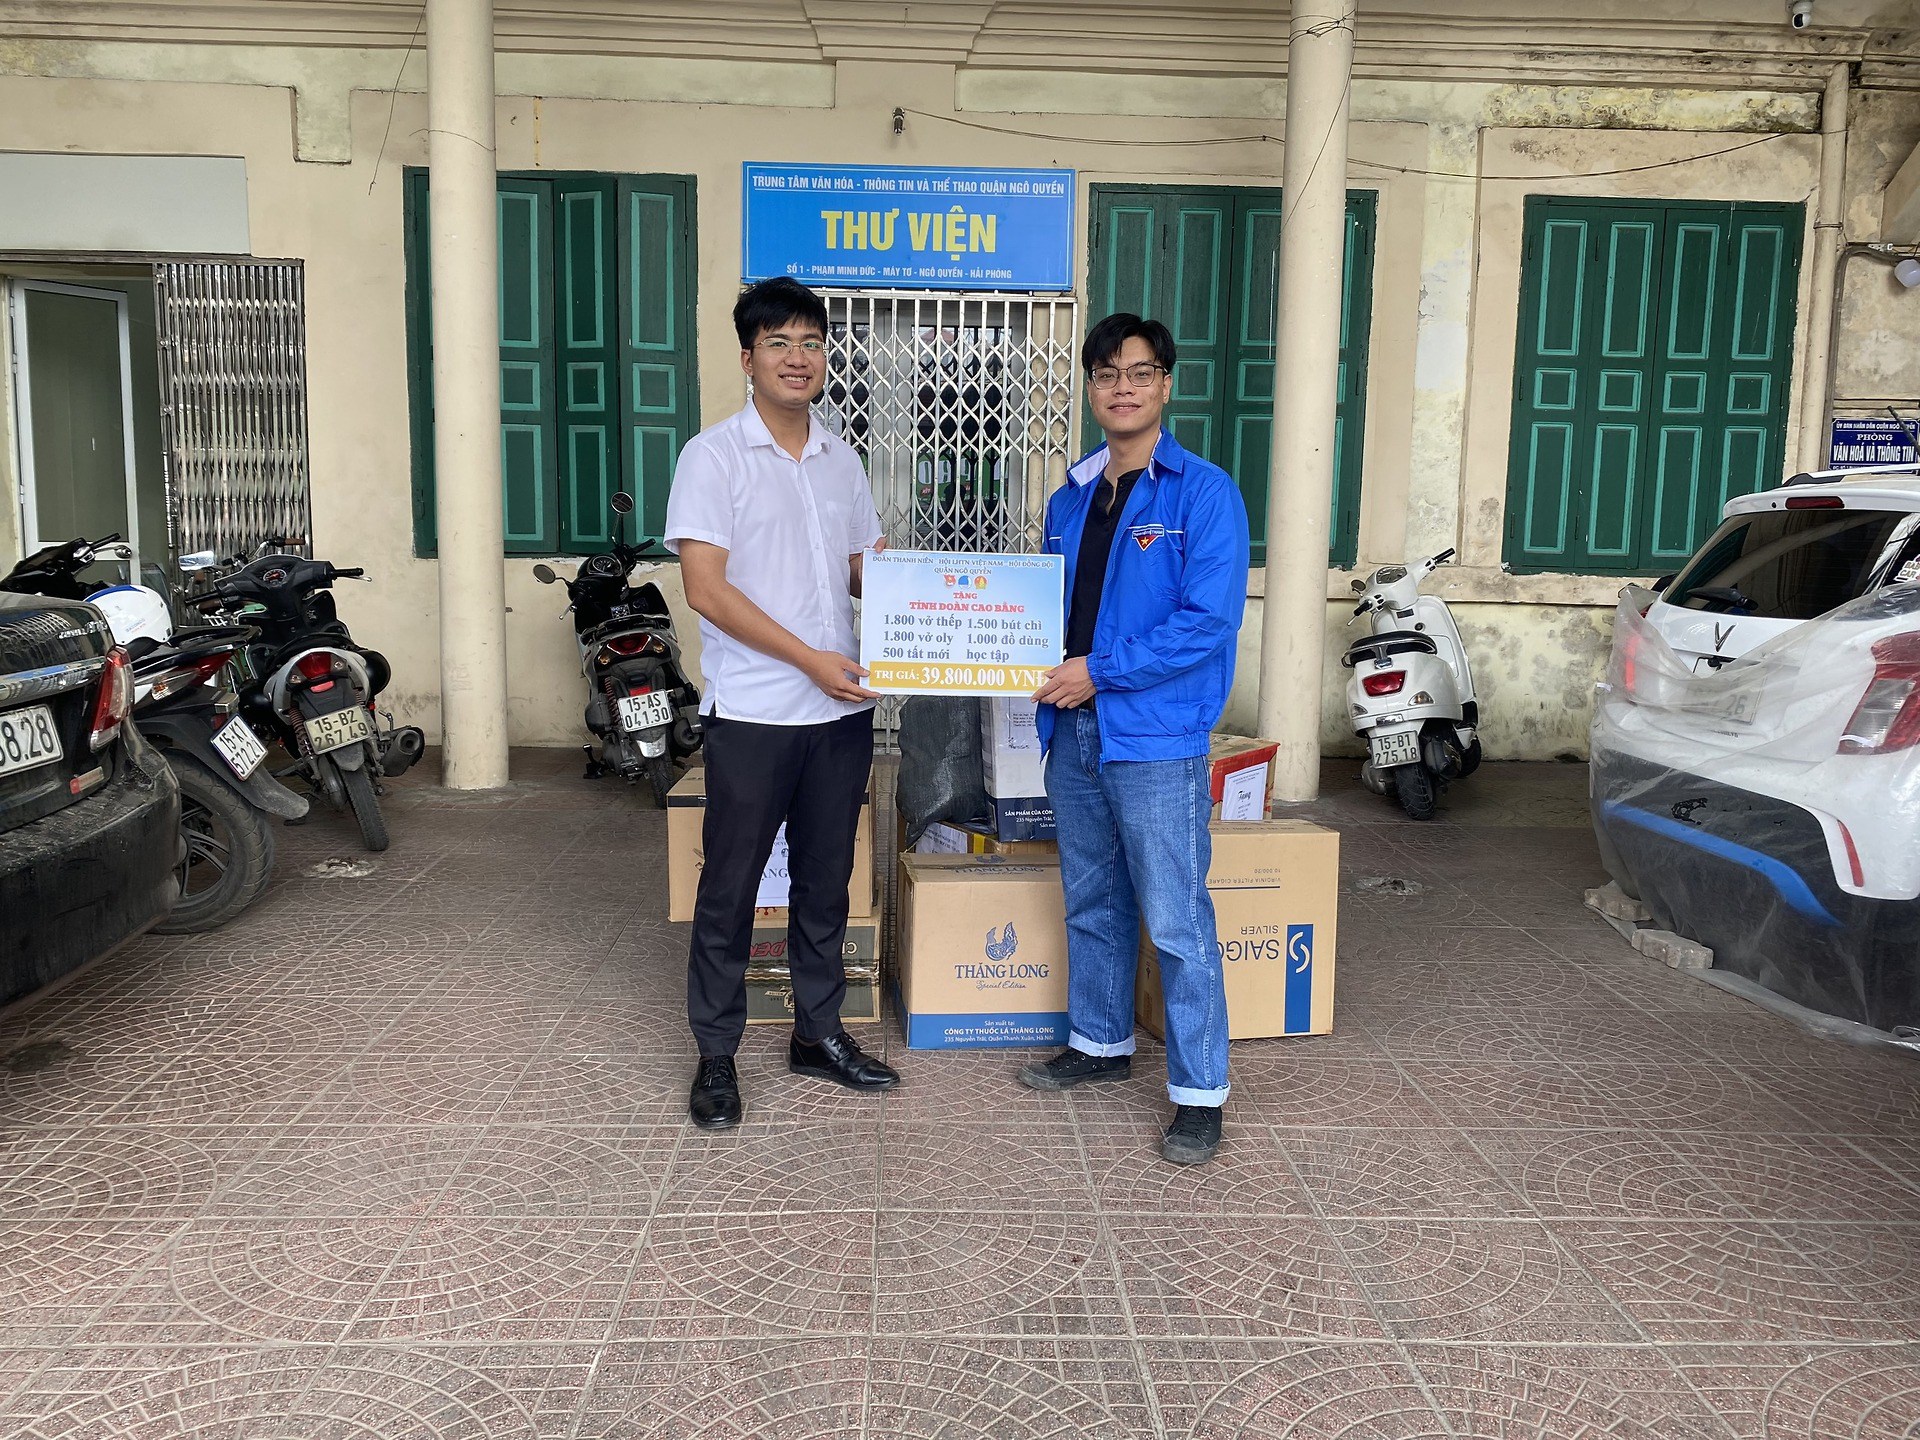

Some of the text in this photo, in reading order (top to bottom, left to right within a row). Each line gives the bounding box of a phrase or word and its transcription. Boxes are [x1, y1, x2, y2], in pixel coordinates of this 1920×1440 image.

[752, 176, 785, 188] TRUNG
[788, 175, 809, 188] TÂM
[811, 176, 832, 189] VĂN
[834, 176, 854, 190] HÓA
[863, 177, 896, 191] THÔNG
[898, 180, 914, 191] TIN
[917, 178, 930, 192] VÀ
[932, 176, 950, 192] THỂ
[952, 180, 977, 193] THAO
[980, 180, 1006, 195] QUẬN
[1010, 180, 1030, 194] NGÔ
[821, 205, 997, 261] THƯ VIỆN
[786, 262, 798, 274] SỐ
[800, 266, 804, 274] 1
[812, 266, 835, 276] PHẠM
[836, 266, 858, 276] MINH
[860, 264, 876, 276] ĐỨC
[882, 264, 900, 276] MÁY
[919, 266, 936, 277] NGÔ
[1834, 442, 1848, 461] VĂN
[1866, 442, 1875, 461] VÀ
[1877, 442, 1900, 462] THÔNG
[1902, 446, 1914, 462] TIN
[953, 591, 978, 600] TẶNG
[909, 600, 937, 610] TỈNH
[939, 601, 969, 612] ĐOÀN
[971, 604, 992, 612] CAO
[884, 614, 962, 629] 1.800 vở thếp
[968, 618, 1042, 630] 1.500 bút chì
[884, 631, 953, 645] 1.800 vở oly
[968, 632, 1049, 648] 1.000 đồ dùng
[883, 645, 950, 659] 500 tất mới
[966, 649, 1009, 663] học tập
[875, 670, 894, 681] TRỊ
[896, 669, 920, 680] GIÁ:
[921, 667, 1006, 686] 39.800.000
[627, 693, 662, 713] 15-AS
[314, 710, 358, 734] 15-B2
[624, 706, 669, 729] 041.30
[219, 720, 248, 754] 15-K1
[314, 722, 368, 750] 267.49
[1378, 734, 1410, 750] 15-B1
[230, 738, 264, 775] 572.21
[1375, 747, 1417, 766] 275.18
[1240, 925, 1279, 935] SILVER
[954, 963, 1049, 978] THĂNG LONG
[976, 980, 1000, 991] Special
[944, 1027, 964, 1035] CÔNG
